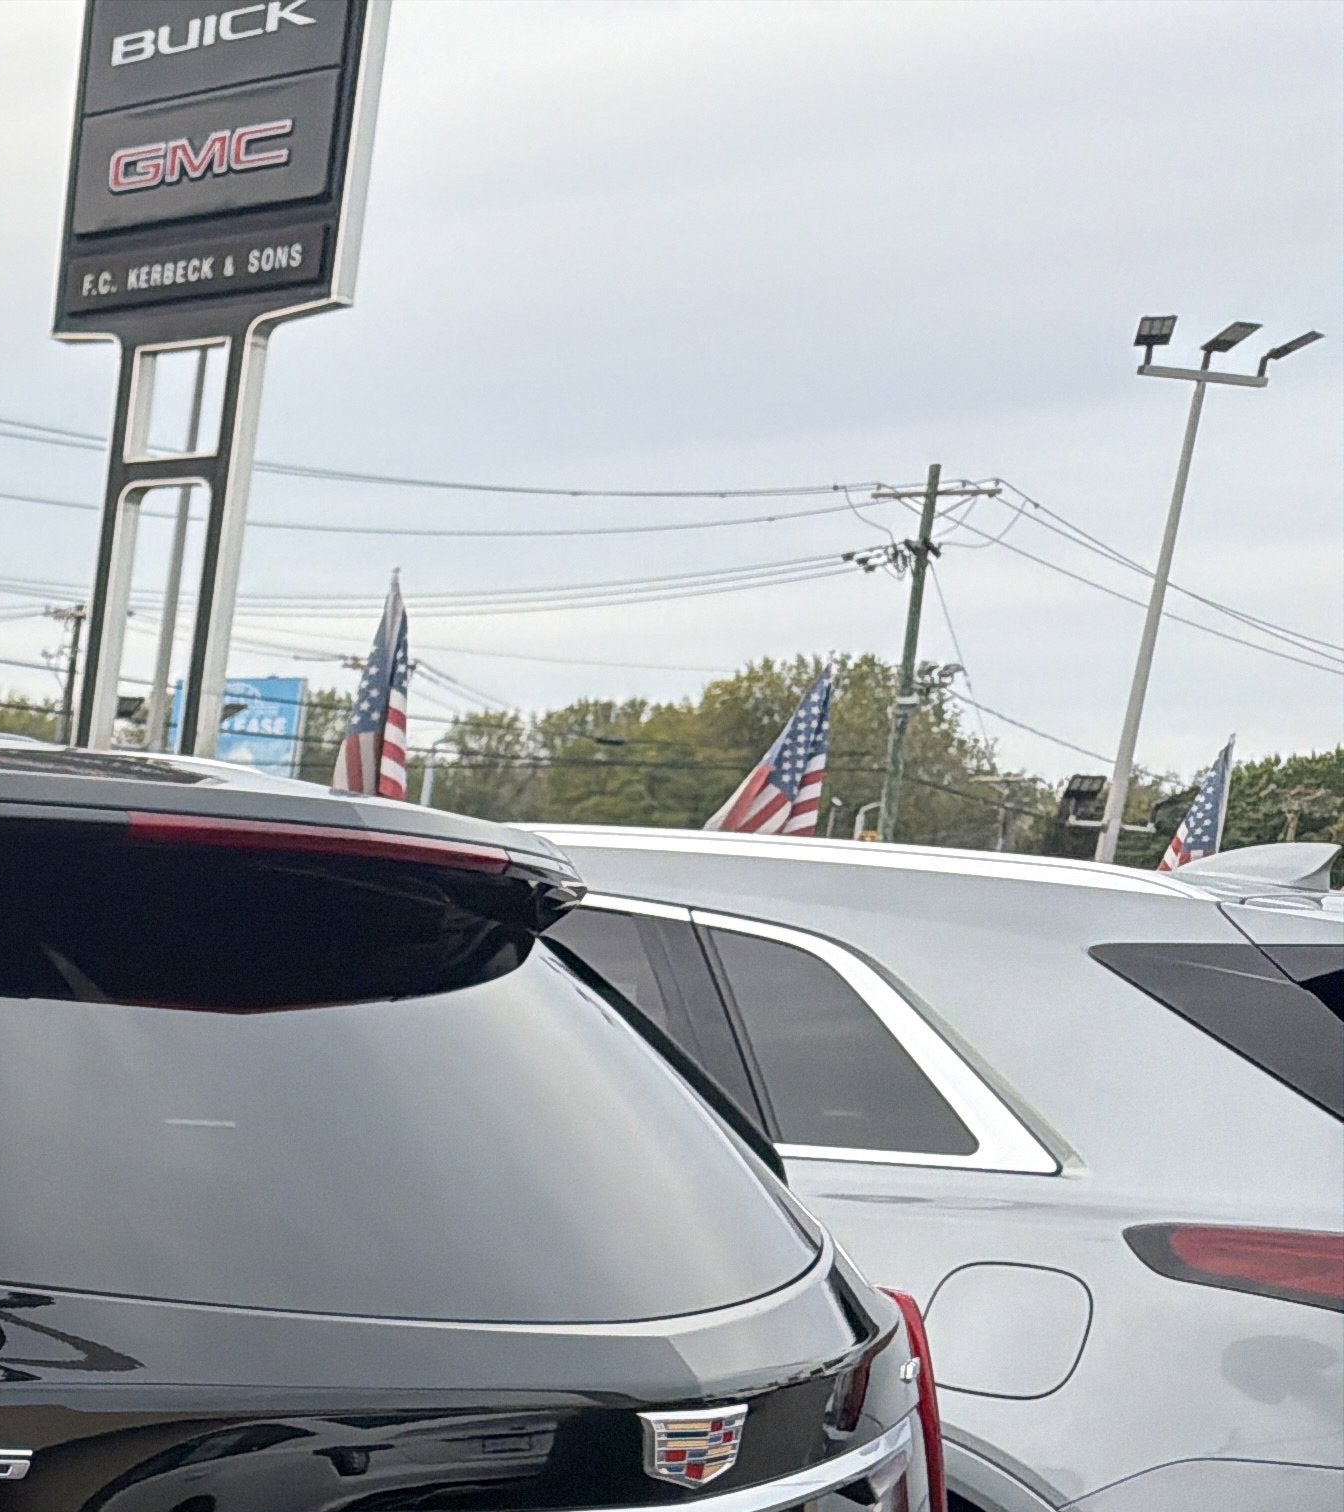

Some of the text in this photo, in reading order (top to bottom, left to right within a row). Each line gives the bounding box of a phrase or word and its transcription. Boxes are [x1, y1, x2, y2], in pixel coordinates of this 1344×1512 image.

[111, 0, 316, 67] BUICK
[109, 118, 293, 192] GMC
[82, 242, 303, 296] F.C. KERBECK & SONS
